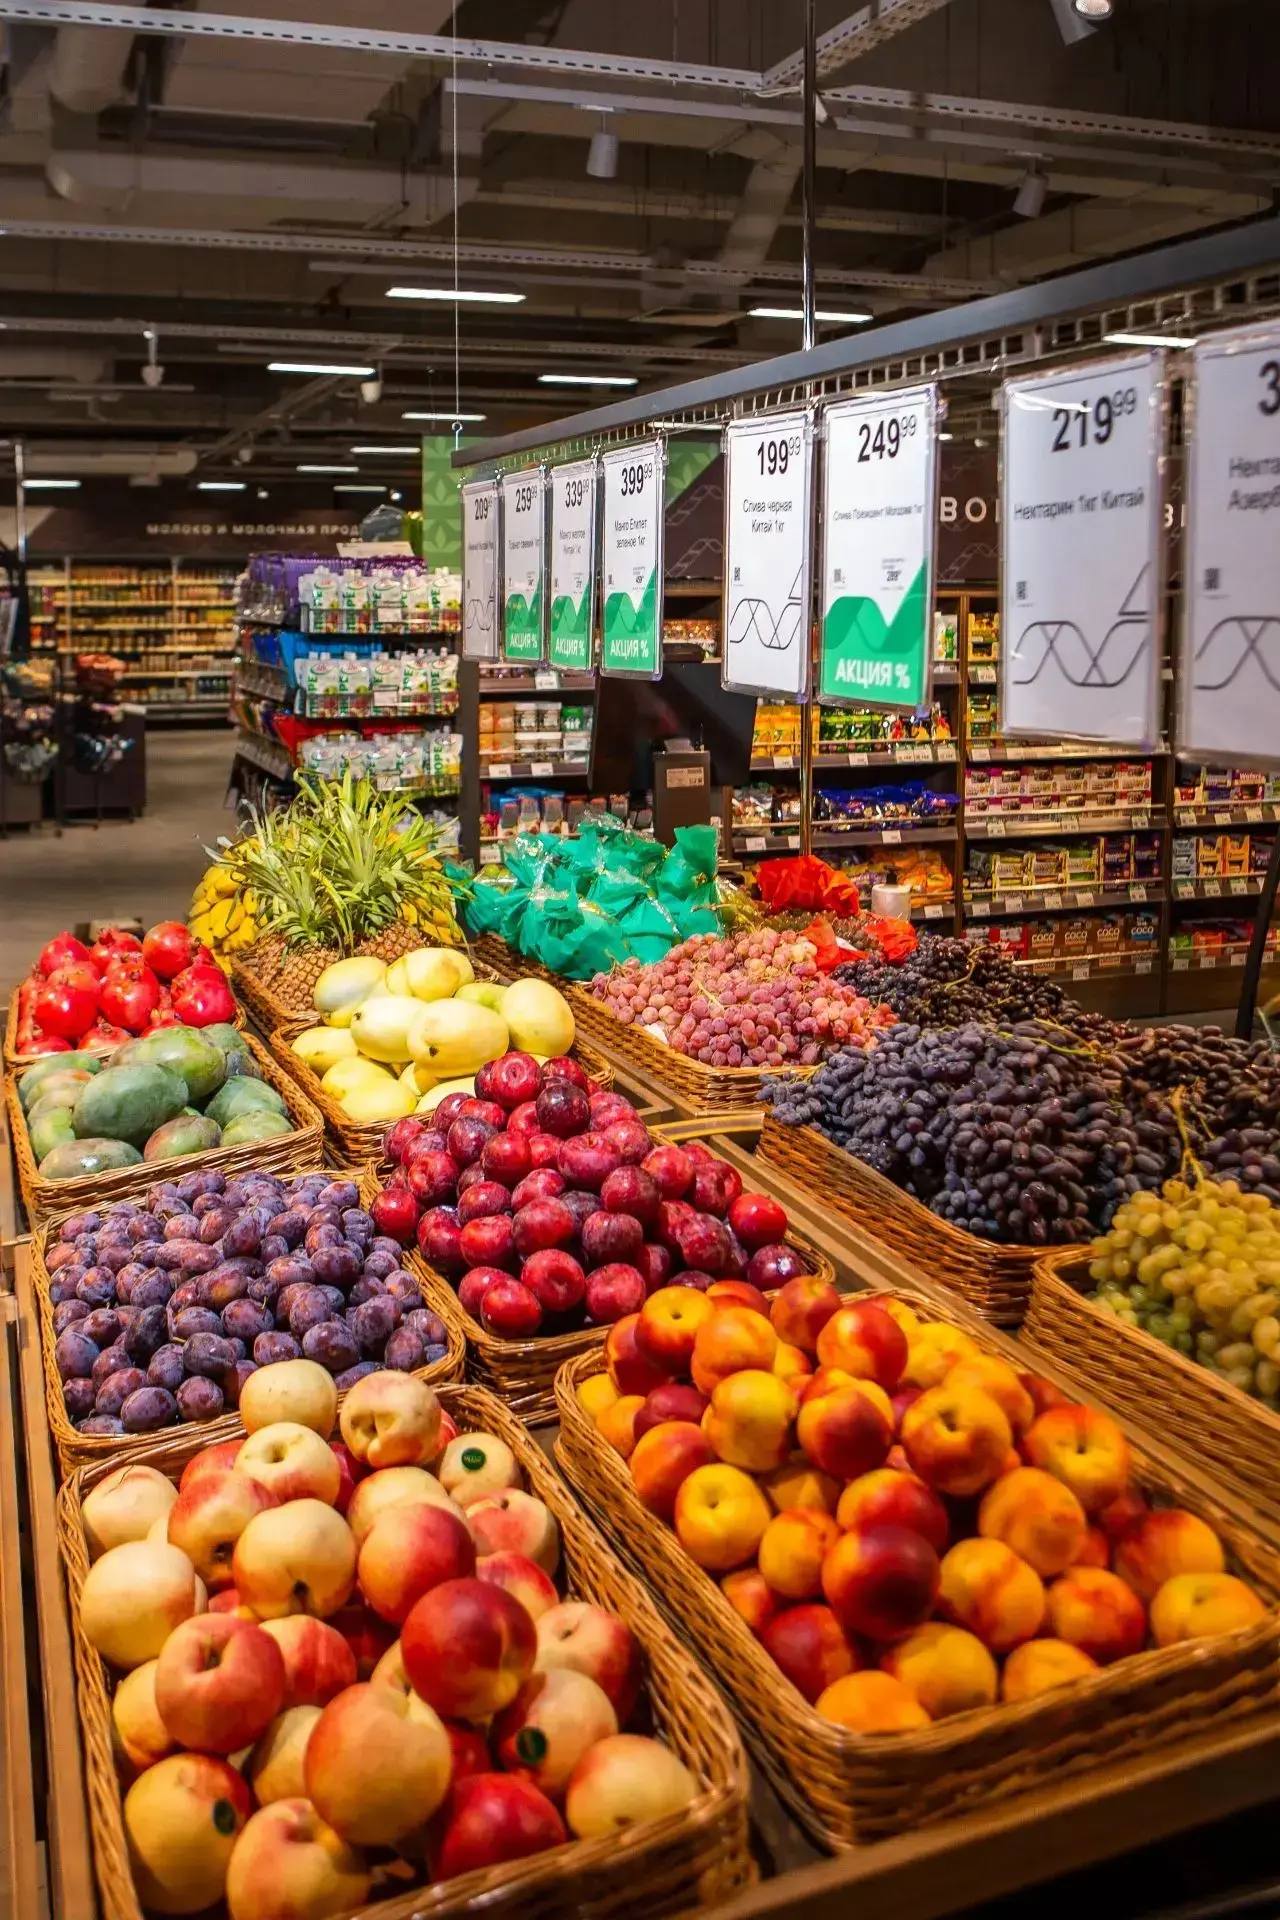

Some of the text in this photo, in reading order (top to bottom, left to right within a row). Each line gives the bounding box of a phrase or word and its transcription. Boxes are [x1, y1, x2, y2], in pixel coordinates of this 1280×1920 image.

[743, 499, 793, 515] Слива черная
[1014, 500, 1075, 520] Нектарин
[1101, 486, 1145, 510] Китай
[146, 524, 213, 536] МОЛОКО
[217, 524, 228, 535] И
[232, 524, 316, 536] МОЛОЧНАЯ
[614, 518, 648, 532] Манго Египет
[751, 519, 785, 534] Китай 1кг
[616, 534, 646, 549] зеленое 1кг
[510, 633, 531, 650] АКЦИЯ
[555, 637, 578, 657] АКЦИЯ
[610, 639, 638, 660] АКЦИЯ
[835, 658, 893, 689] АКЦИЯ
